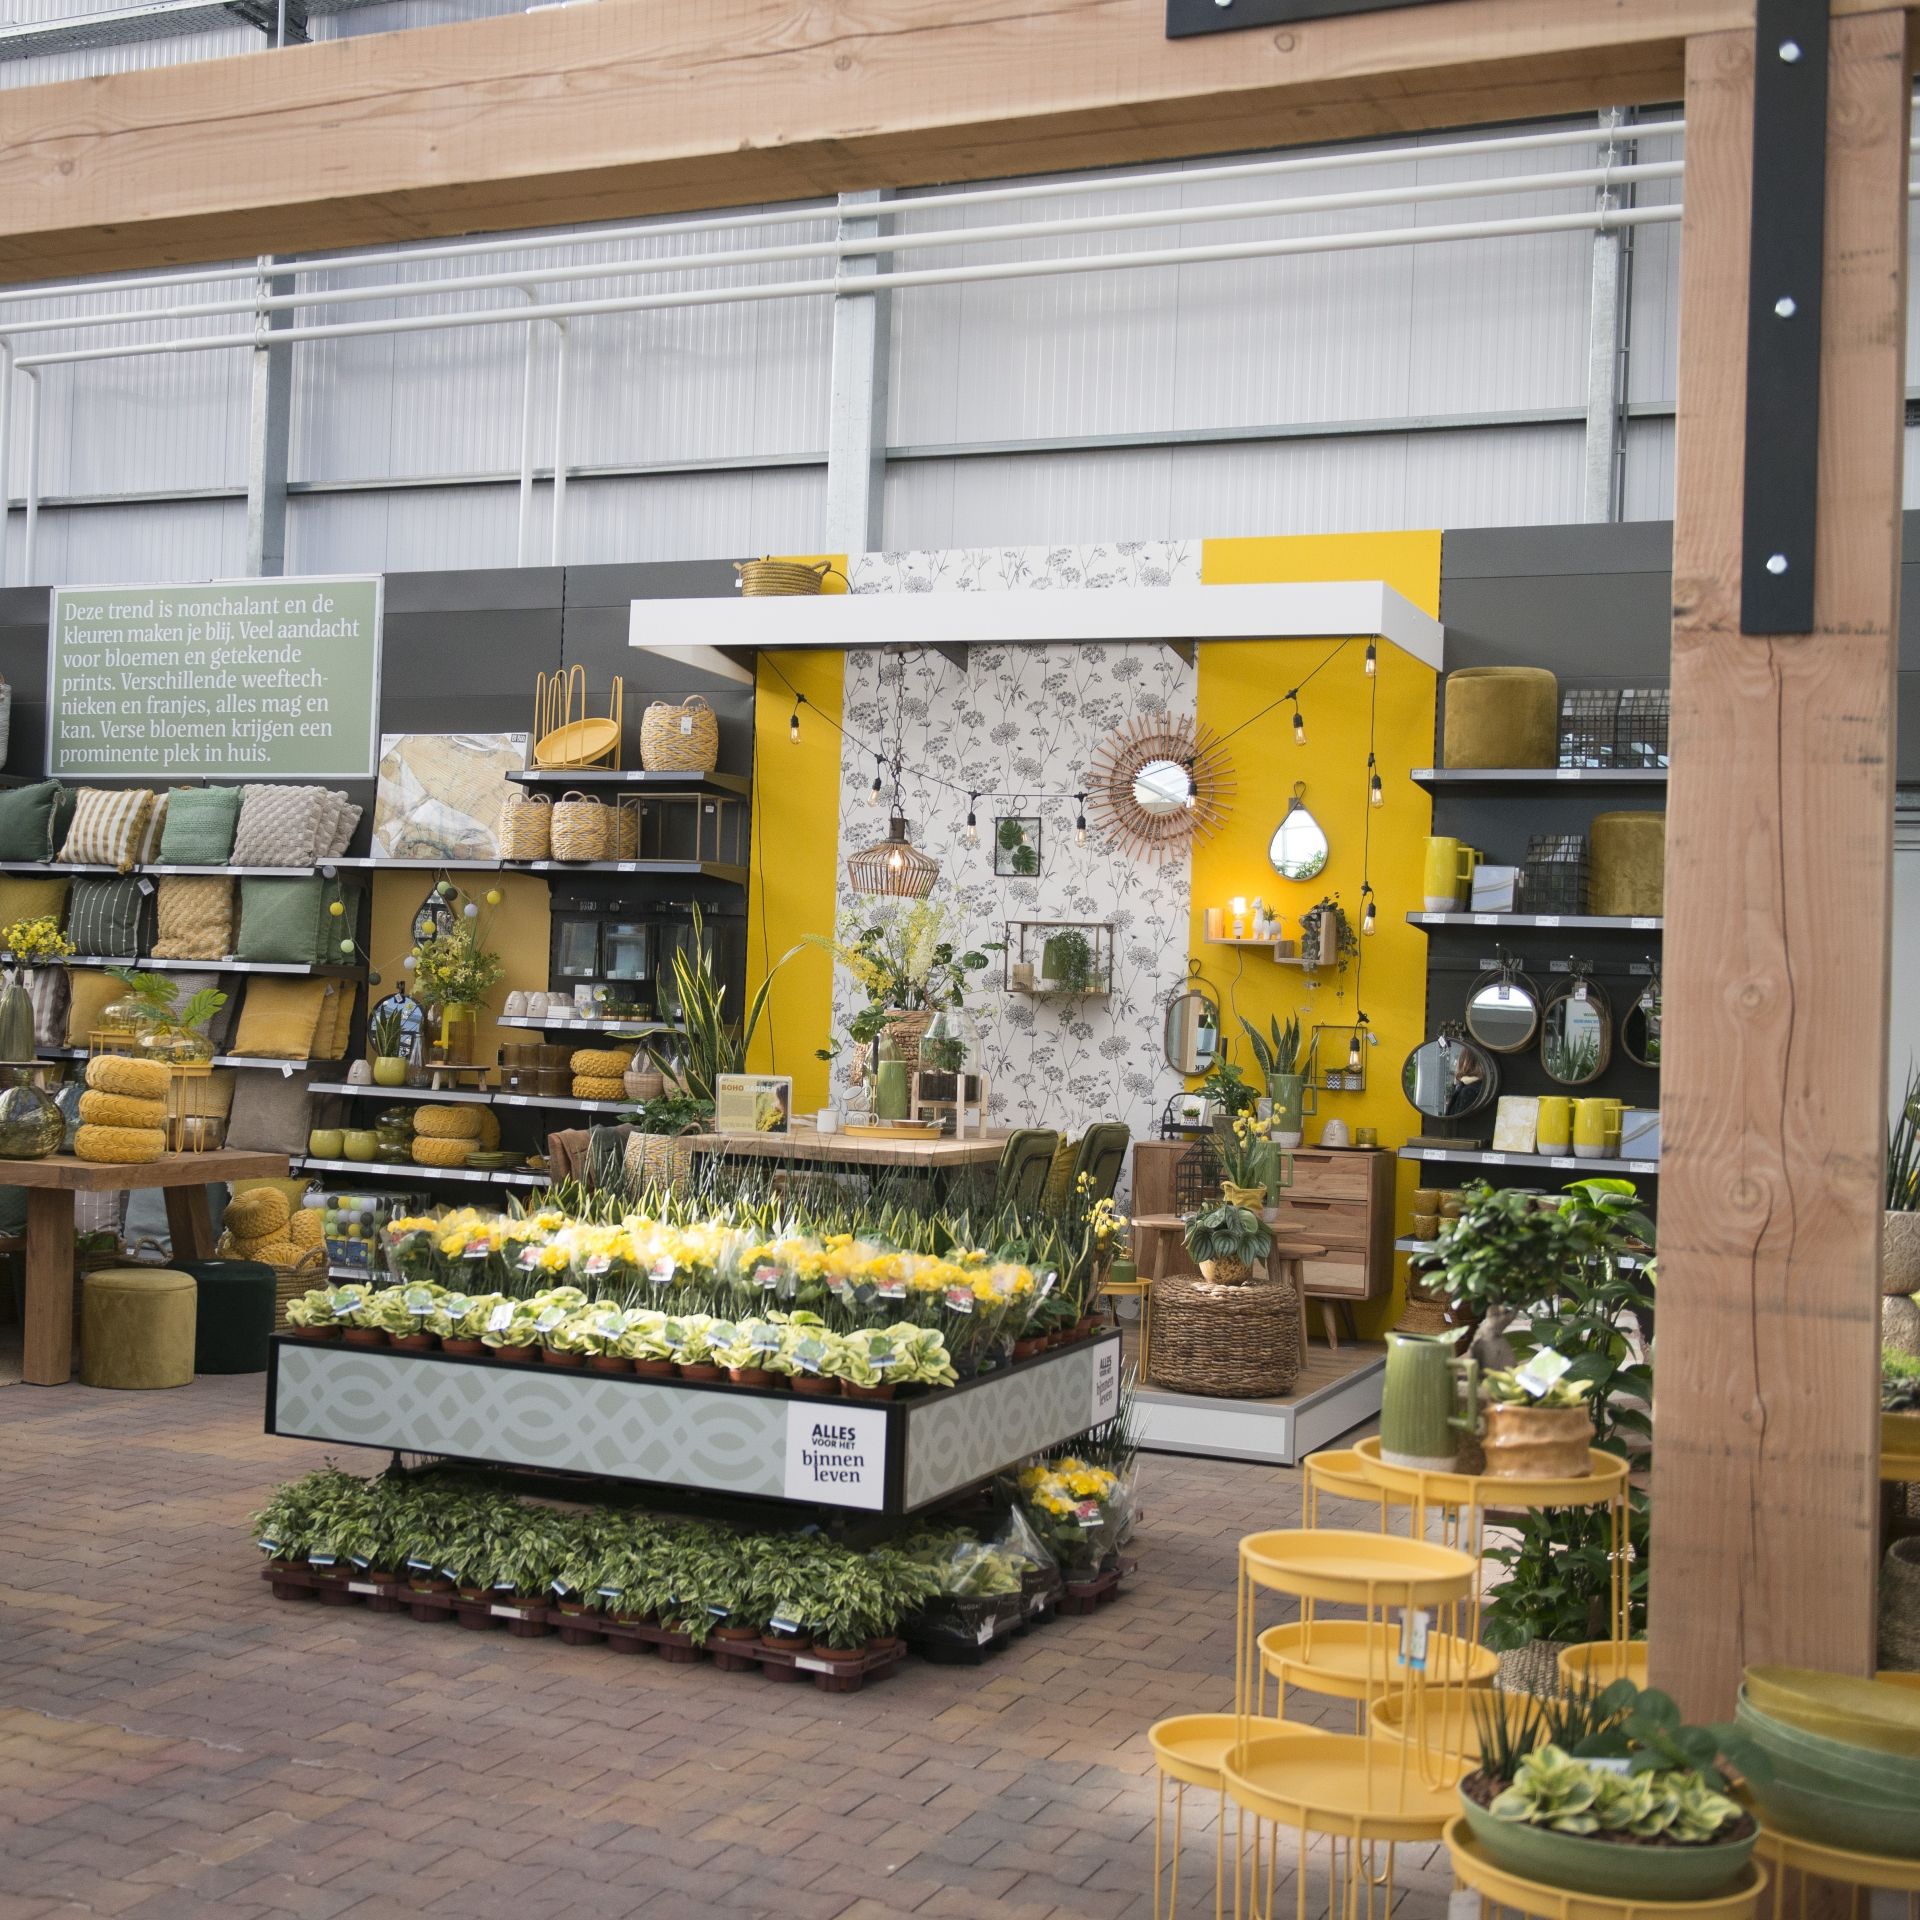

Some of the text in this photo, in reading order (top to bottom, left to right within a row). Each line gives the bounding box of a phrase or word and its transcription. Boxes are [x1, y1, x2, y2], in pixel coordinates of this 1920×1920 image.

[65, 594, 333, 620] Deze trend is nonchalant en de
[64, 618, 359, 645] kleuren maken je blij. Veel aandacht
[64, 645, 301, 669] voor bloemen en getekende
[62, 669, 328, 696] prints. Verschillende weeftech-
[62, 695, 328, 718] nieken en franjes, alles mag en
[61, 719, 332, 742] kan. Verse bloemen krijgen een
[60, 743, 270, 767] prominente plek in huis.
[1100, 1355, 1111, 1369] ALLES
[811, 1437, 855, 1450] VOOR HET
[812, 1424, 856, 1440] ALLES
[802, 1449, 864, 1467] binnen
[814, 1466, 861, 1482] leven
